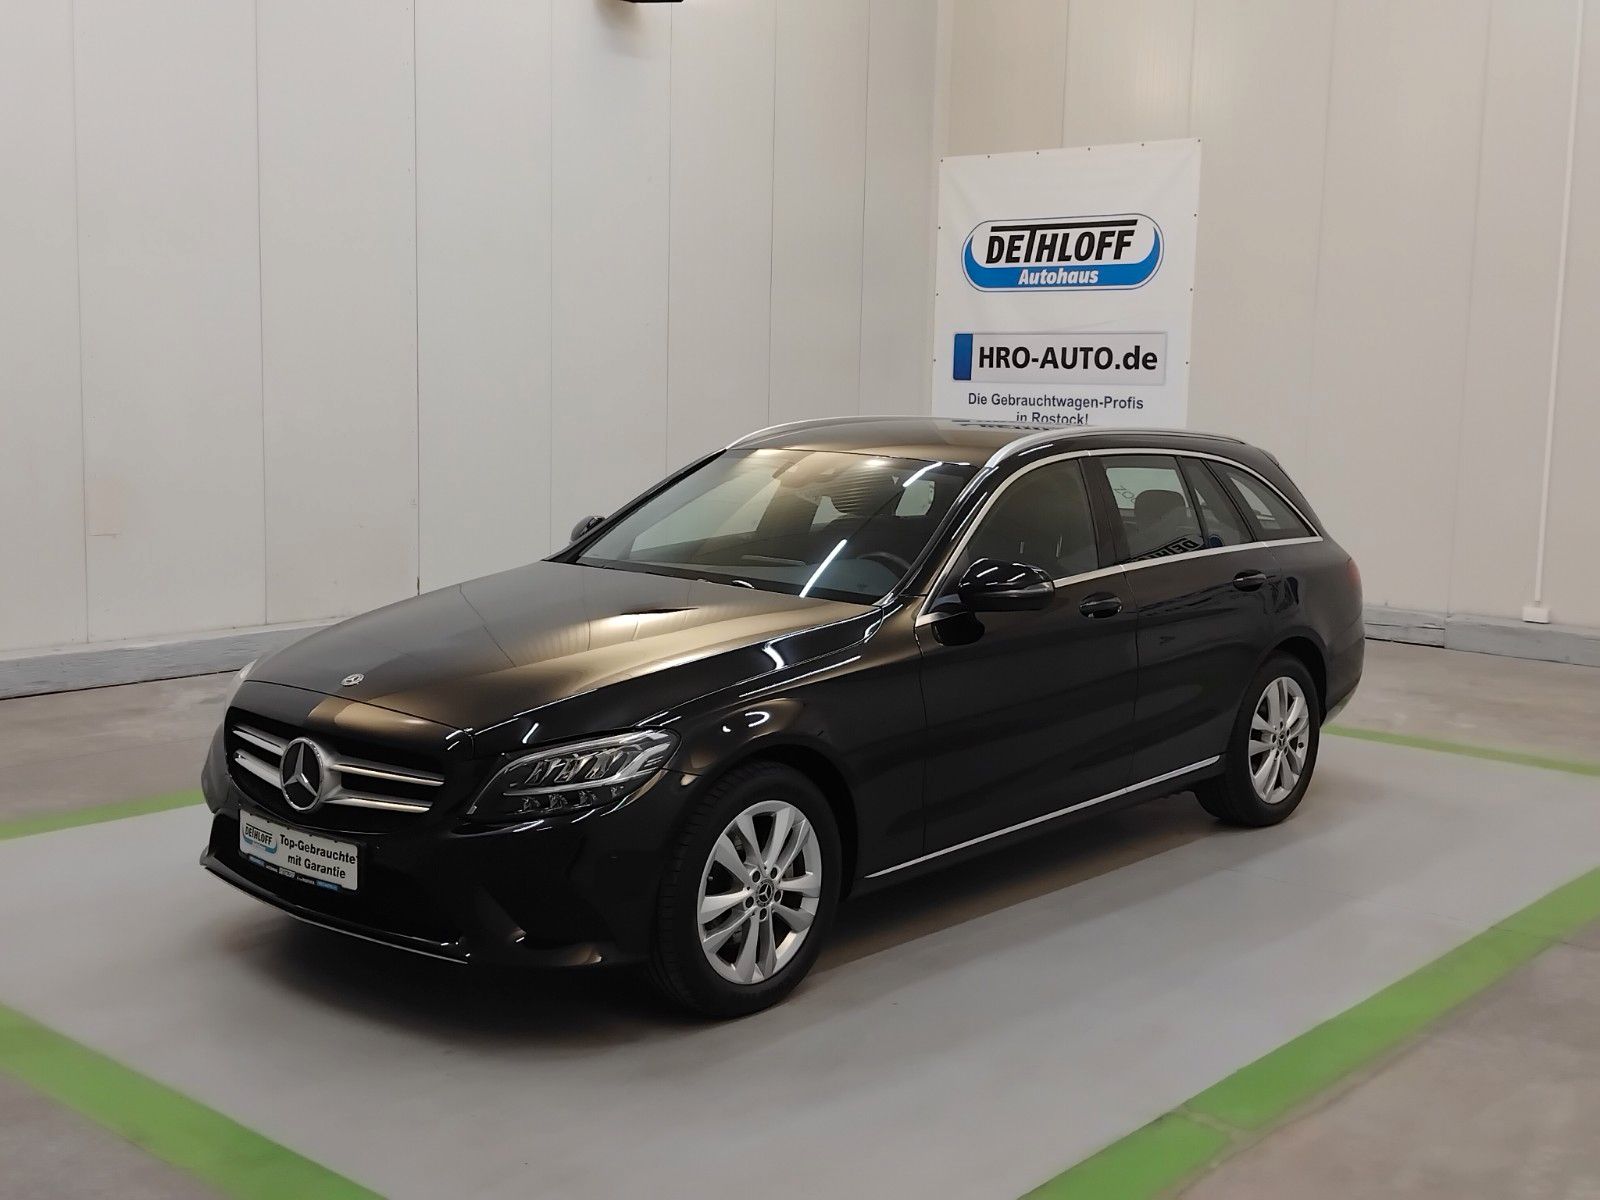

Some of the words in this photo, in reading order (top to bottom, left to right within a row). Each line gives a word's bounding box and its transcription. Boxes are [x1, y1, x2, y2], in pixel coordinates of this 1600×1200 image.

[986, 219, 1138, 264] DETHLOFF
[1018, 268, 1099, 285] Autohaus
[978, 345, 1158, 370] HRO-AUTO.de
[968, 392, 988, 405] Die
[991, 393, 1144, 410] Gebrauchtwagen-Profis
[1016, 412, 1027, 423] in
[1032, 412, 1089, 425] Rostock!
[245, 823, 273, 846] DETHLOFF
[287, 855, 302, 866] mit
[304, 858, 346, 879] Garantie
